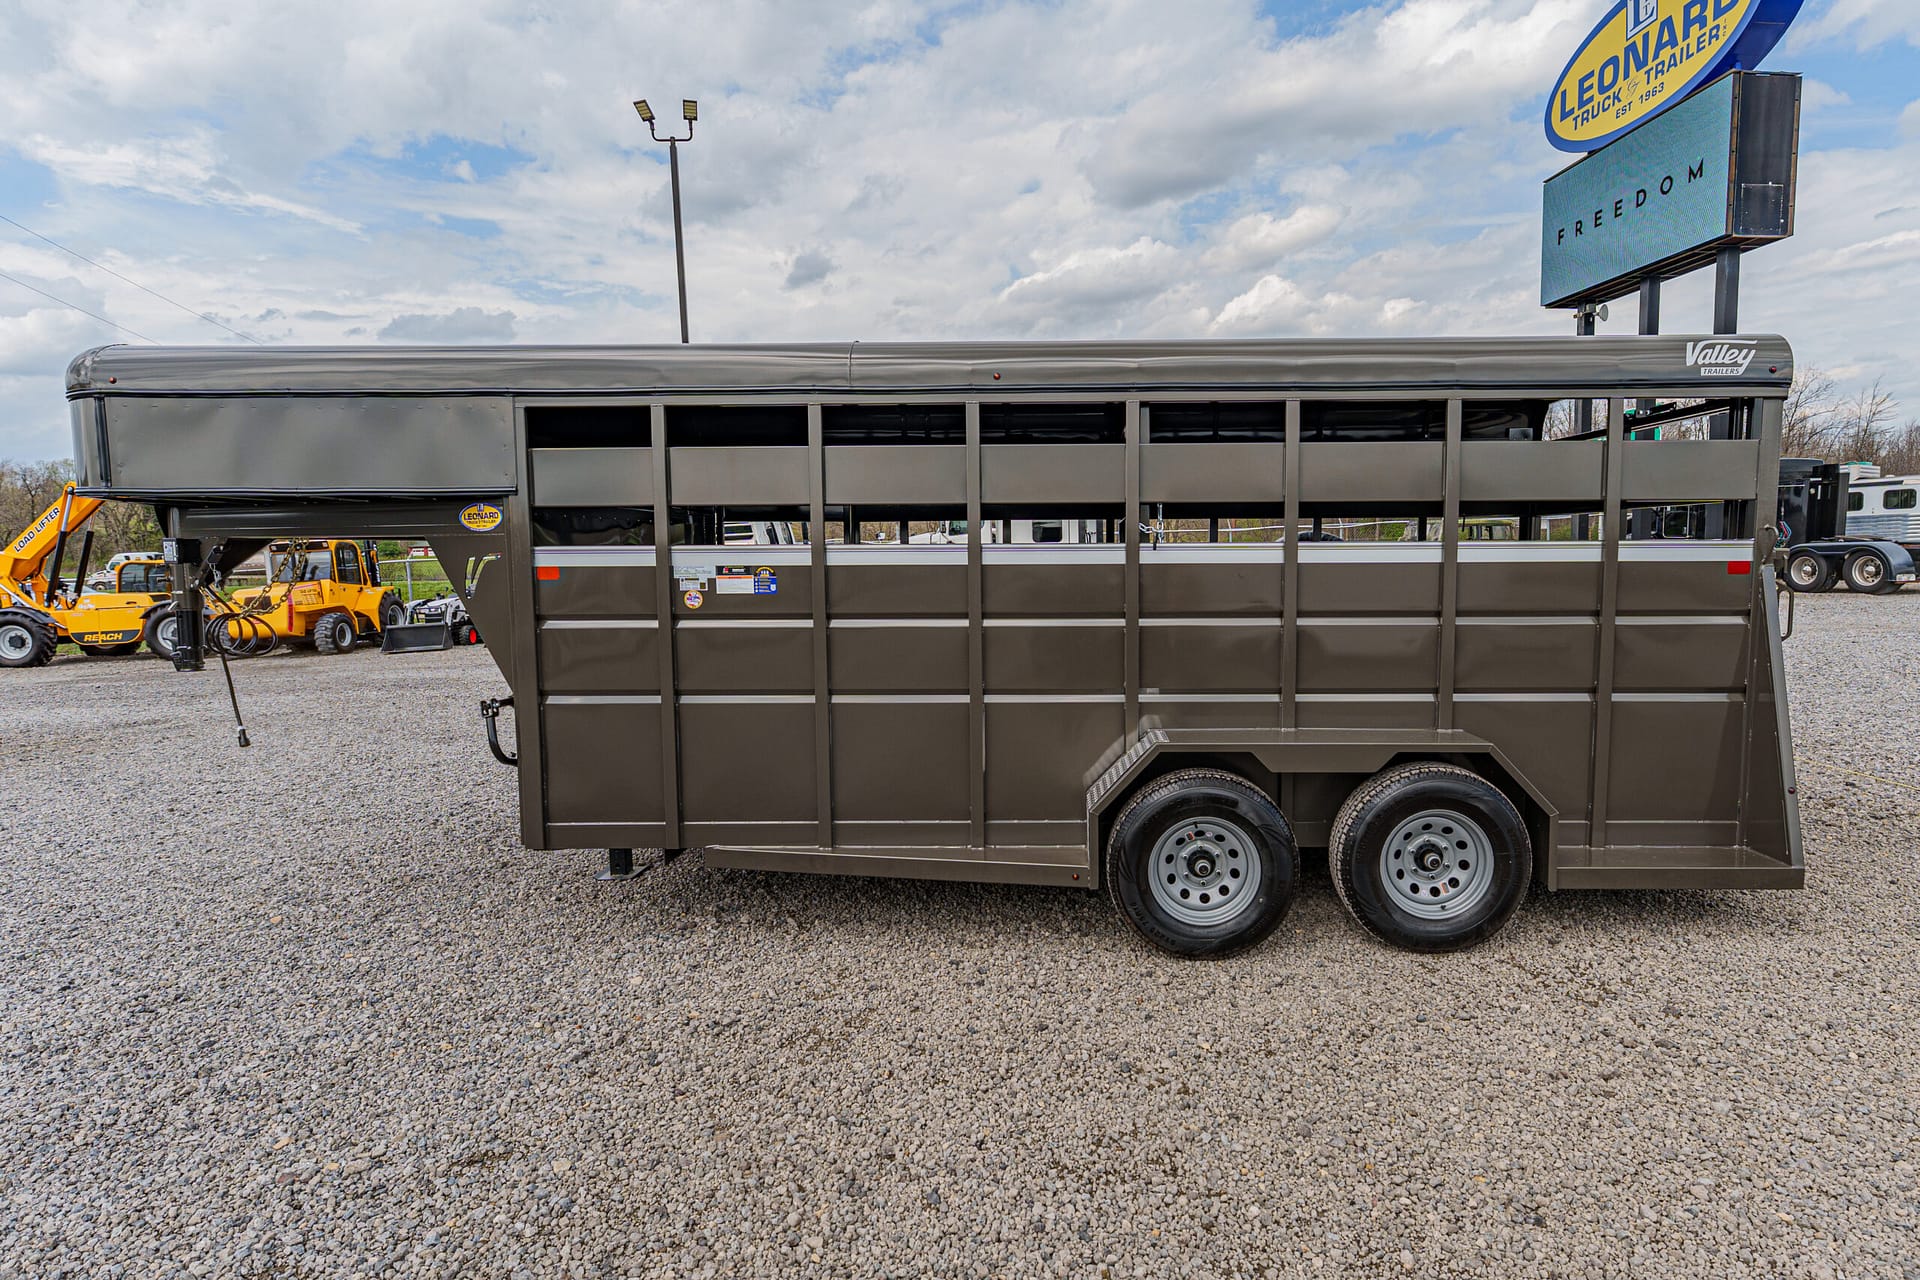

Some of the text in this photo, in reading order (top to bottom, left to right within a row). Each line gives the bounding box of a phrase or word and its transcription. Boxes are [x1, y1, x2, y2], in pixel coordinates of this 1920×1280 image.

[1560, 0, 1739, 122] LEONARD
[1572, 90, 1623, 131] TRUCK
[1644, 24, 1721, 85] TRAILER
[1615, 83, 1665, 120] EST 1963
[1557, 158, 1704, 246] FREEDOM
[1686, 340, 1757, 373] Valley
[14, 507, 60, 552] LOAD LIFTER
[464, 512, 498, 520] LEONARD
[84, 632, 123, 642] REACH
